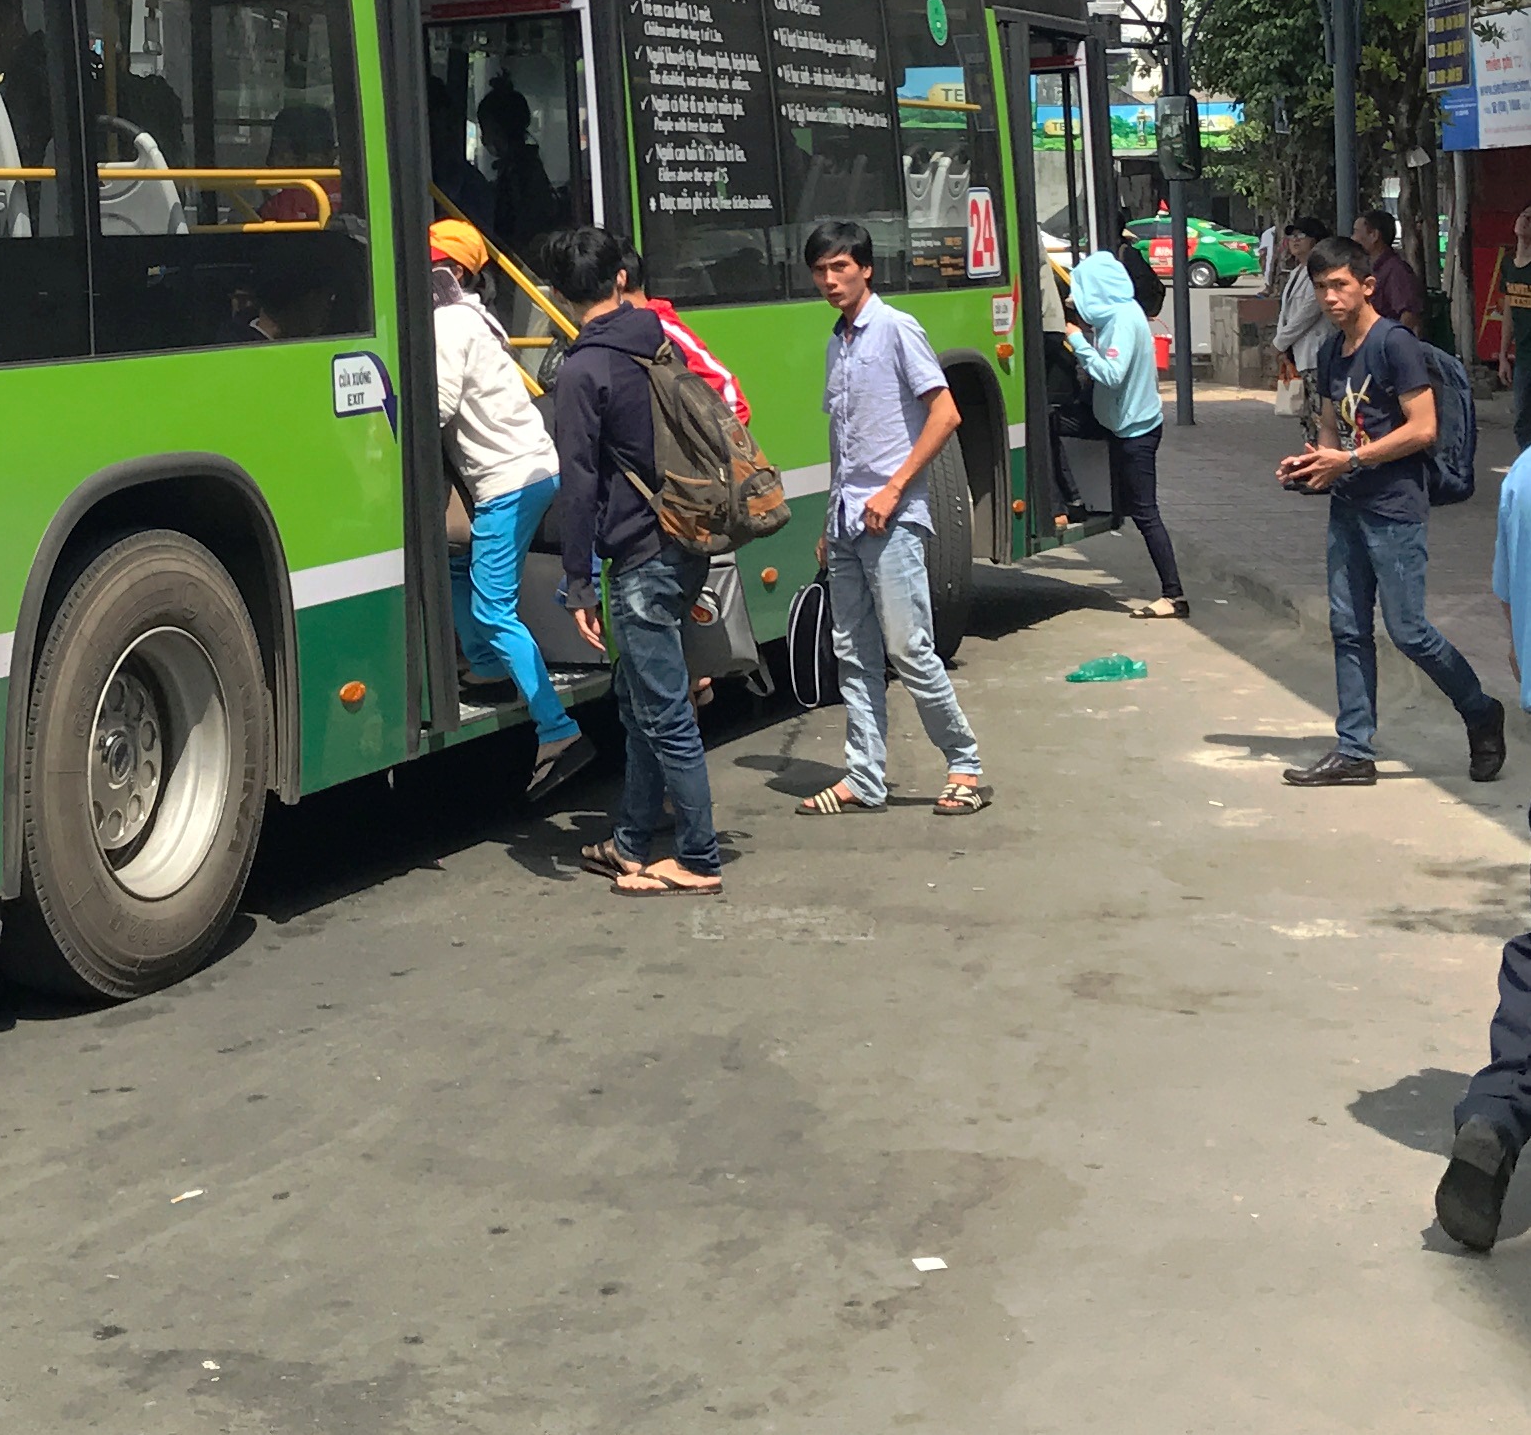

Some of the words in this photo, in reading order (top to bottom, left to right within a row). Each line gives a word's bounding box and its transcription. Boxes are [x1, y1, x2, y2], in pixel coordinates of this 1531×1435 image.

[941, 88, 964, 102] TE
[1198, 118, 1216, 128] EA
[969, 198, 995, 268] 24
[347, 391, 365, 407] EXIT
